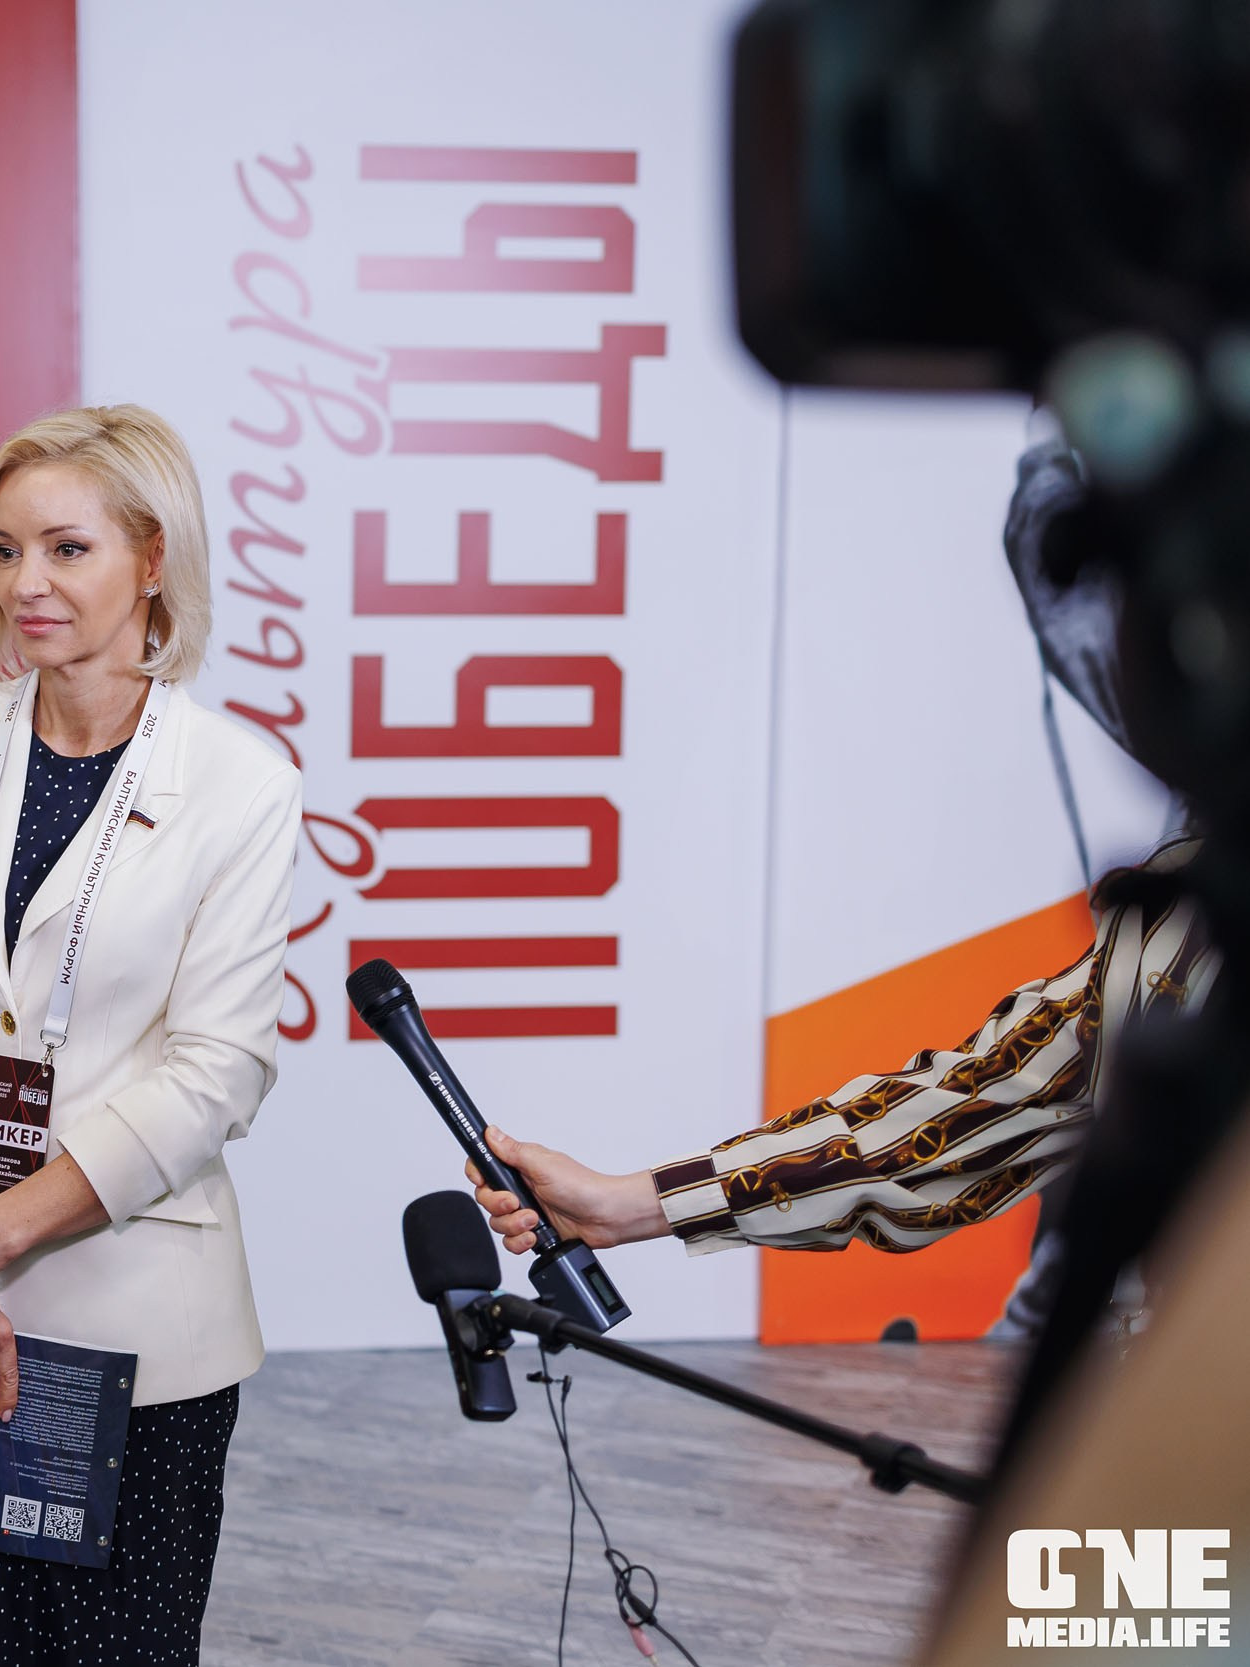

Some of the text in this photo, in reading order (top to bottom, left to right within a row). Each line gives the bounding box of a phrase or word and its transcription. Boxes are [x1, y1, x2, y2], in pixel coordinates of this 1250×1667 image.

[347, 144, 668, 1042] ПОБЕДЫ
[141, 713, 158, 739] 2025
[60, 770, 137, 985] БАЛТИЙСКИЙ КУЛЬТУРНЫЙ ФОРУМ
[18, 1090, 49, 1106] ПОБЕДЫ
[438, 1084, 477, 1139] SENNHEISER
[476, 1142, 488, 1154] MD
